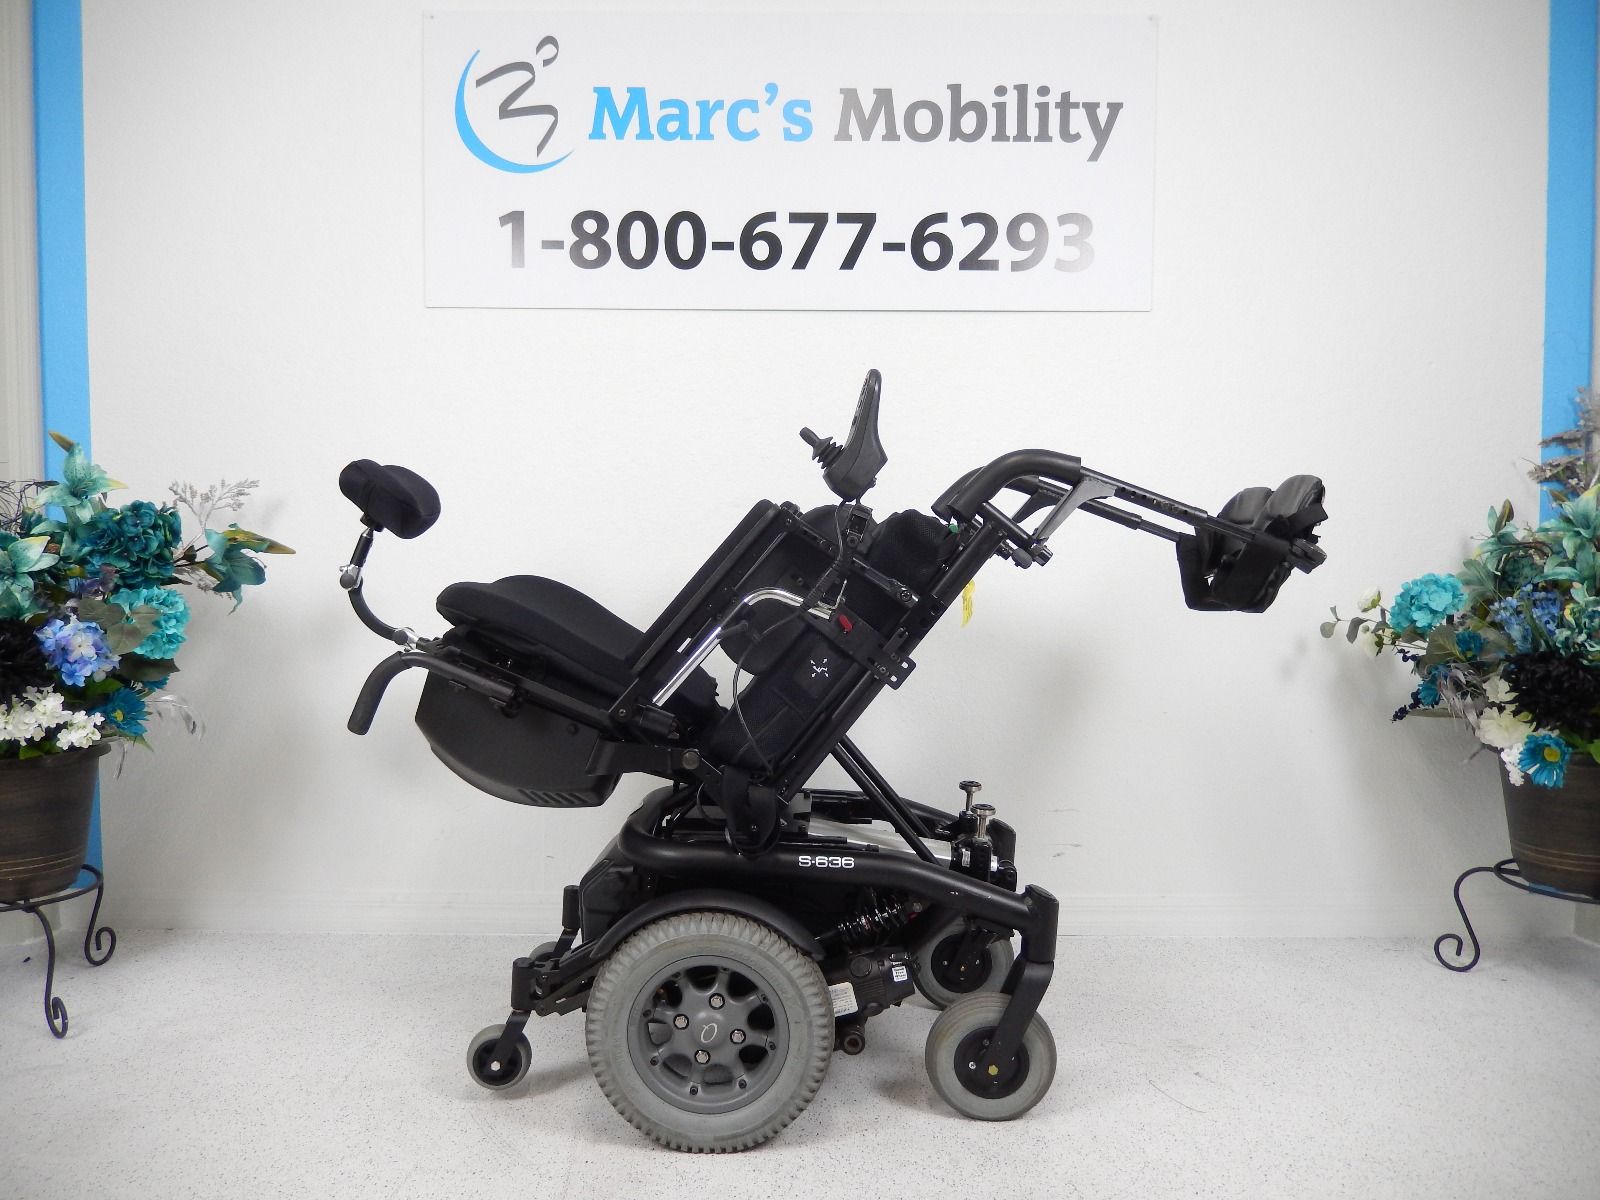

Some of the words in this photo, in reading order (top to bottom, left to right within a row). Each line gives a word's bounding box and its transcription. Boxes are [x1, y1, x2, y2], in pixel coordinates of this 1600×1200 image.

[588, 82, 814, 143] Marc's
[833, 83, 1124, 163] Mobility
[498, 209, 1096, 273] 1-800-677-6293
